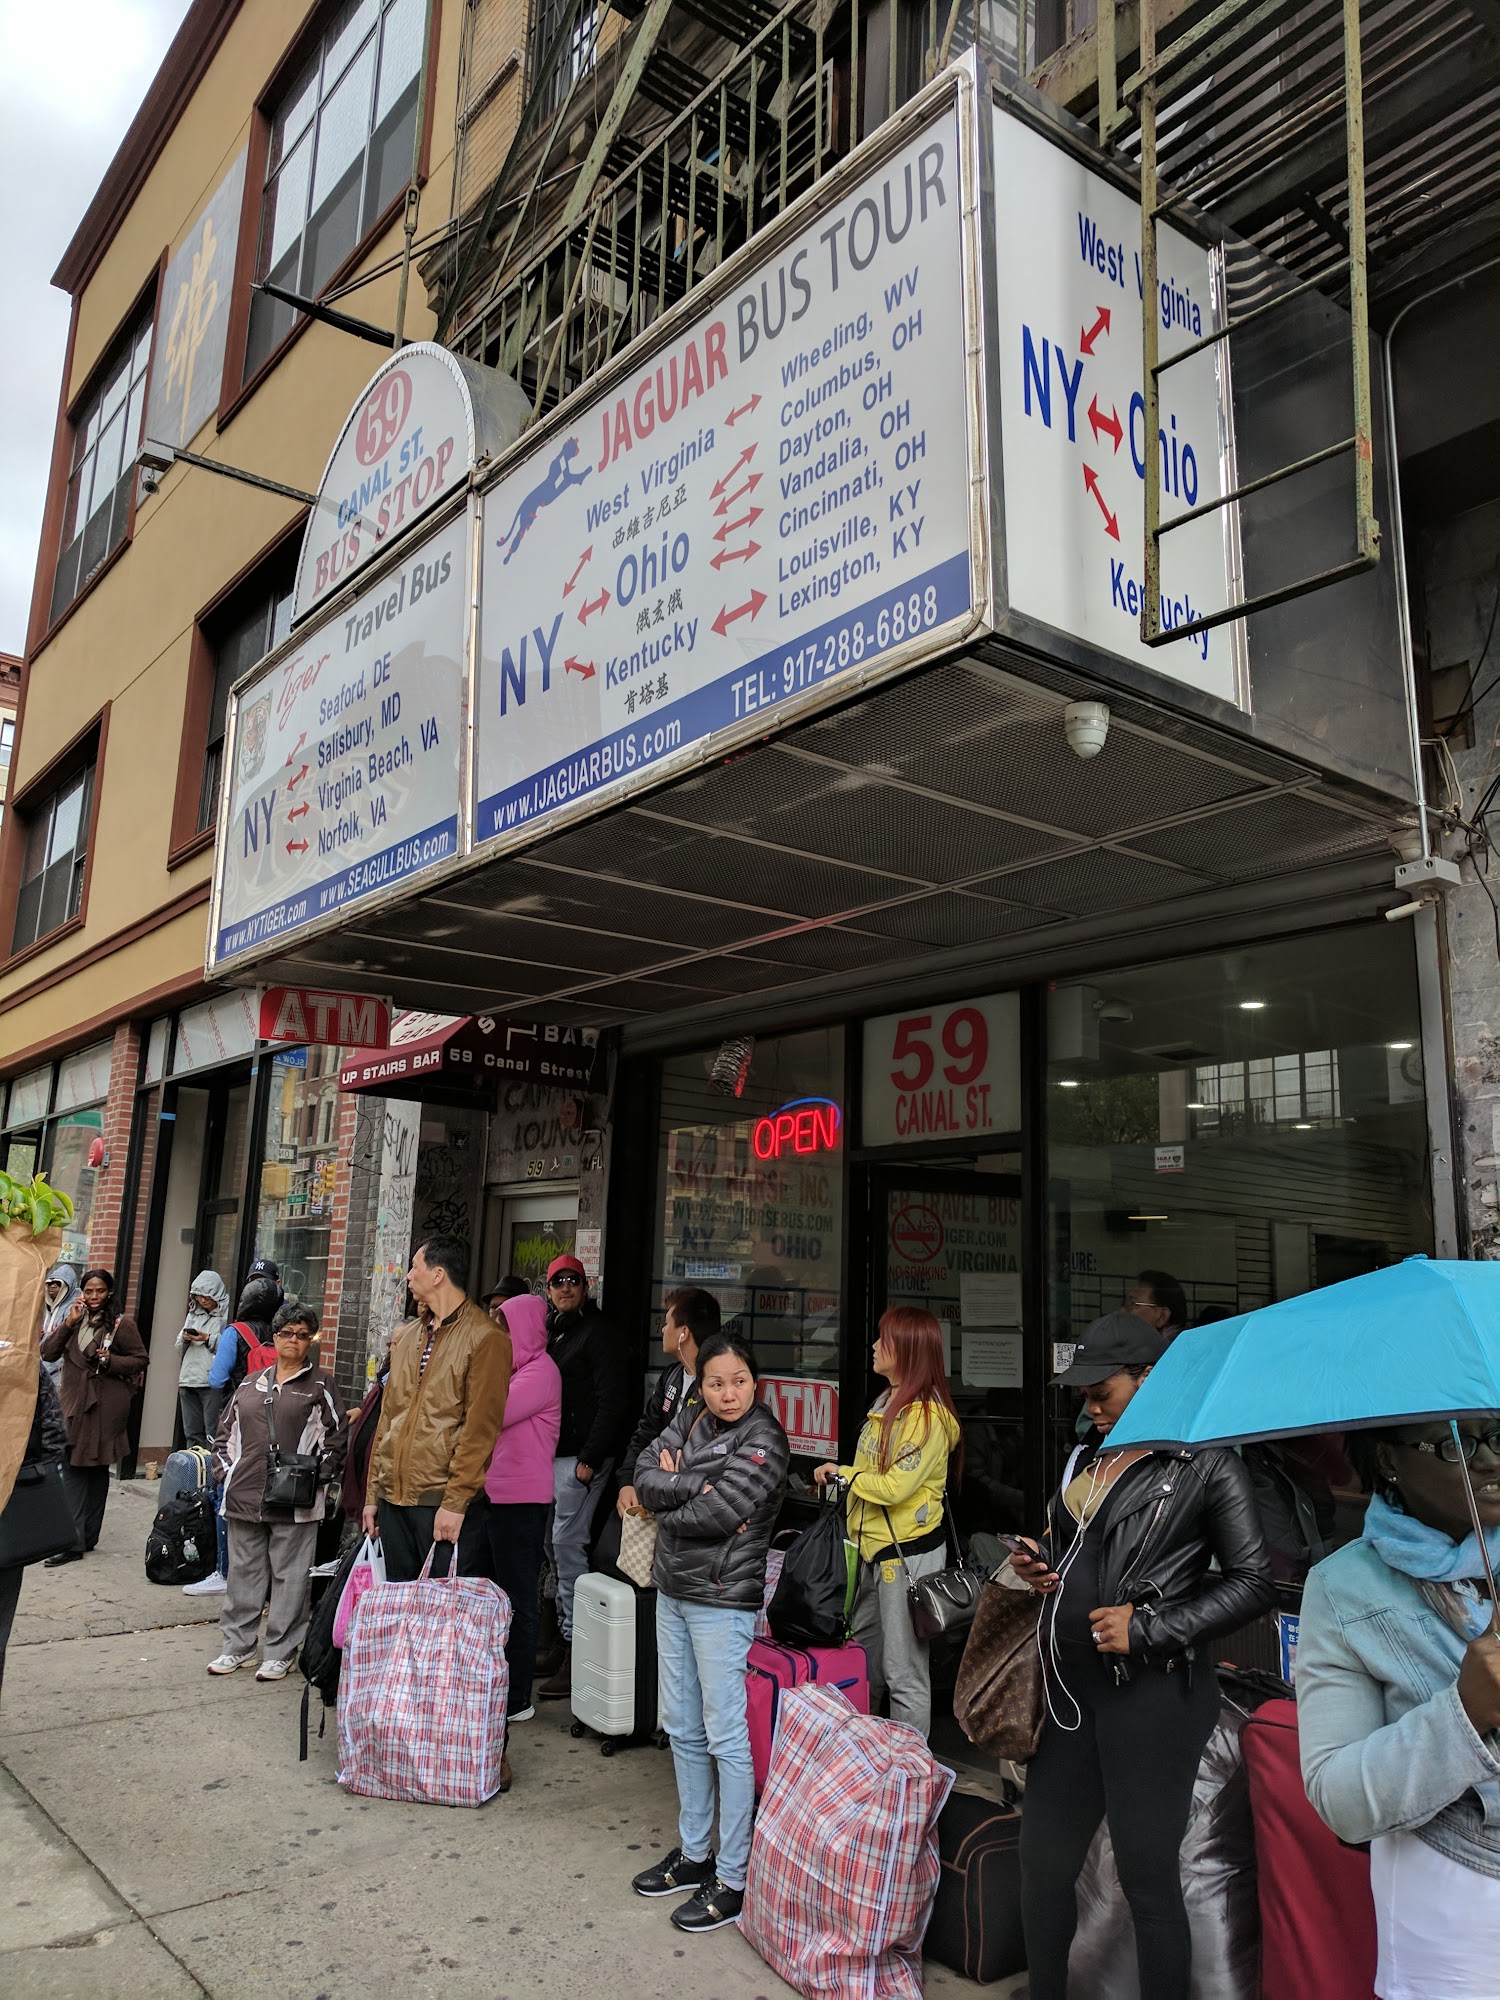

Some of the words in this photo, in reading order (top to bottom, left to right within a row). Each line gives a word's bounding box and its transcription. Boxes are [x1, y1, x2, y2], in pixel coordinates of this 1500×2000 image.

[598, 320, 729, 474] JAGUAR
[737, 248, 812, 364] BUS
[820, 142, 947, 293] TOUR
[1077, 211, 1124, 288] West
[1134, 251, 1202, 338] Vginia
[780, 350, 881, 428] Columbus,
[891, 308, 922, 351] OH
[781, 311, 874, 388] Wheeling,
[883, 265, 919, 315] WV
[363, 372, 407, 467] 59
[779, 407, 852, 466] Dayton,
[862, 370, 893, 411] OH
[1022, 324, 1084, 444] NY
[338, 461, 392, 529] CANAL
[399, 426, 424, 473] ST.
[586, 482, 630, 534] West
[640, 427, 715, 495] Virginia
[779, 460, 884, 539] Cincinnati,
[895, 430, 927, 472] OH
[780, 436, 869, 500] Vandalia,
[879, 400, 911, 440] OH
[312, 519, 362, 598] BUS
[375, 437, 454, 543] STOP
[612, 483, 688, 550] 西維吉尼亞
[779, 512, 878, 583] Louisville,
[888, 479, 922, 523] KY
[616, 530, 690, 608] Ohio
[779, 550, 881, 619] Lexington,
[892, 516, 926, 559] KY
[277, 653, 331, 731] Tiger
[345, 575, 406, 653] Travel
[410, 551, 452, 606] Bus
[605, 616, 699, 690] Kentucky
[636, 588, 684, 635] 俄亥俄
[731, 669, 777, 719] TEL:
[783, 585, 938, 694] 917-288-6888
[319, 670, 367, 726] Seaford,
[373, 651, 391, 688] DE
[500, 612, 564, 717] NY
[624, 672, 669, 715] 肯塔基
[318, 716, 375, 769] Salisbury,
[381, 691, 401, 729] MD
[318, 766, 362, 812] Virginia
[368, 736, 413, 783] Beach,
[420, 716, 439, 752] VA
[493, 718, 682, 832] www.IJAGUARBUS.com
[244, 789, 277, 858] NY
[318, 812, 363, 857] Norfolk,
[370, 794, 387, 828] VA
[225, 899, 307, 953] www.NYTIGER.com
[320, 831, 449, 909] www.SEAGULLBUS.com
[272, 990, 378, 1047] ATM
[394, 1023, 441, 1043] BAR
[449, 1048, 473, 1063] 59
[484, 1053, 529, 1072] Canal
[890, 1007, 989, 1092] 59
[342, 1071, 357, 1085] UP
[362, 1059, 407, 1081] STAIRS
[412, 1050, 440, 1070] BAR
[896, 1089, 959, 1135] CANAL
[966, 1084, 993, 1129] ST.
[528, 1161, 543, 1176] 59
[752, 1104, 837, 1161] OPEN
[682, 1225, 715, 1251] NY
[771, 1235, 822, 1261] OHIO
[988, 1198, 1017, 1227] BUS
[945, 1250, 1017, 1272] VIRGINIA
[763, 1381, 832, 1439] ATM
